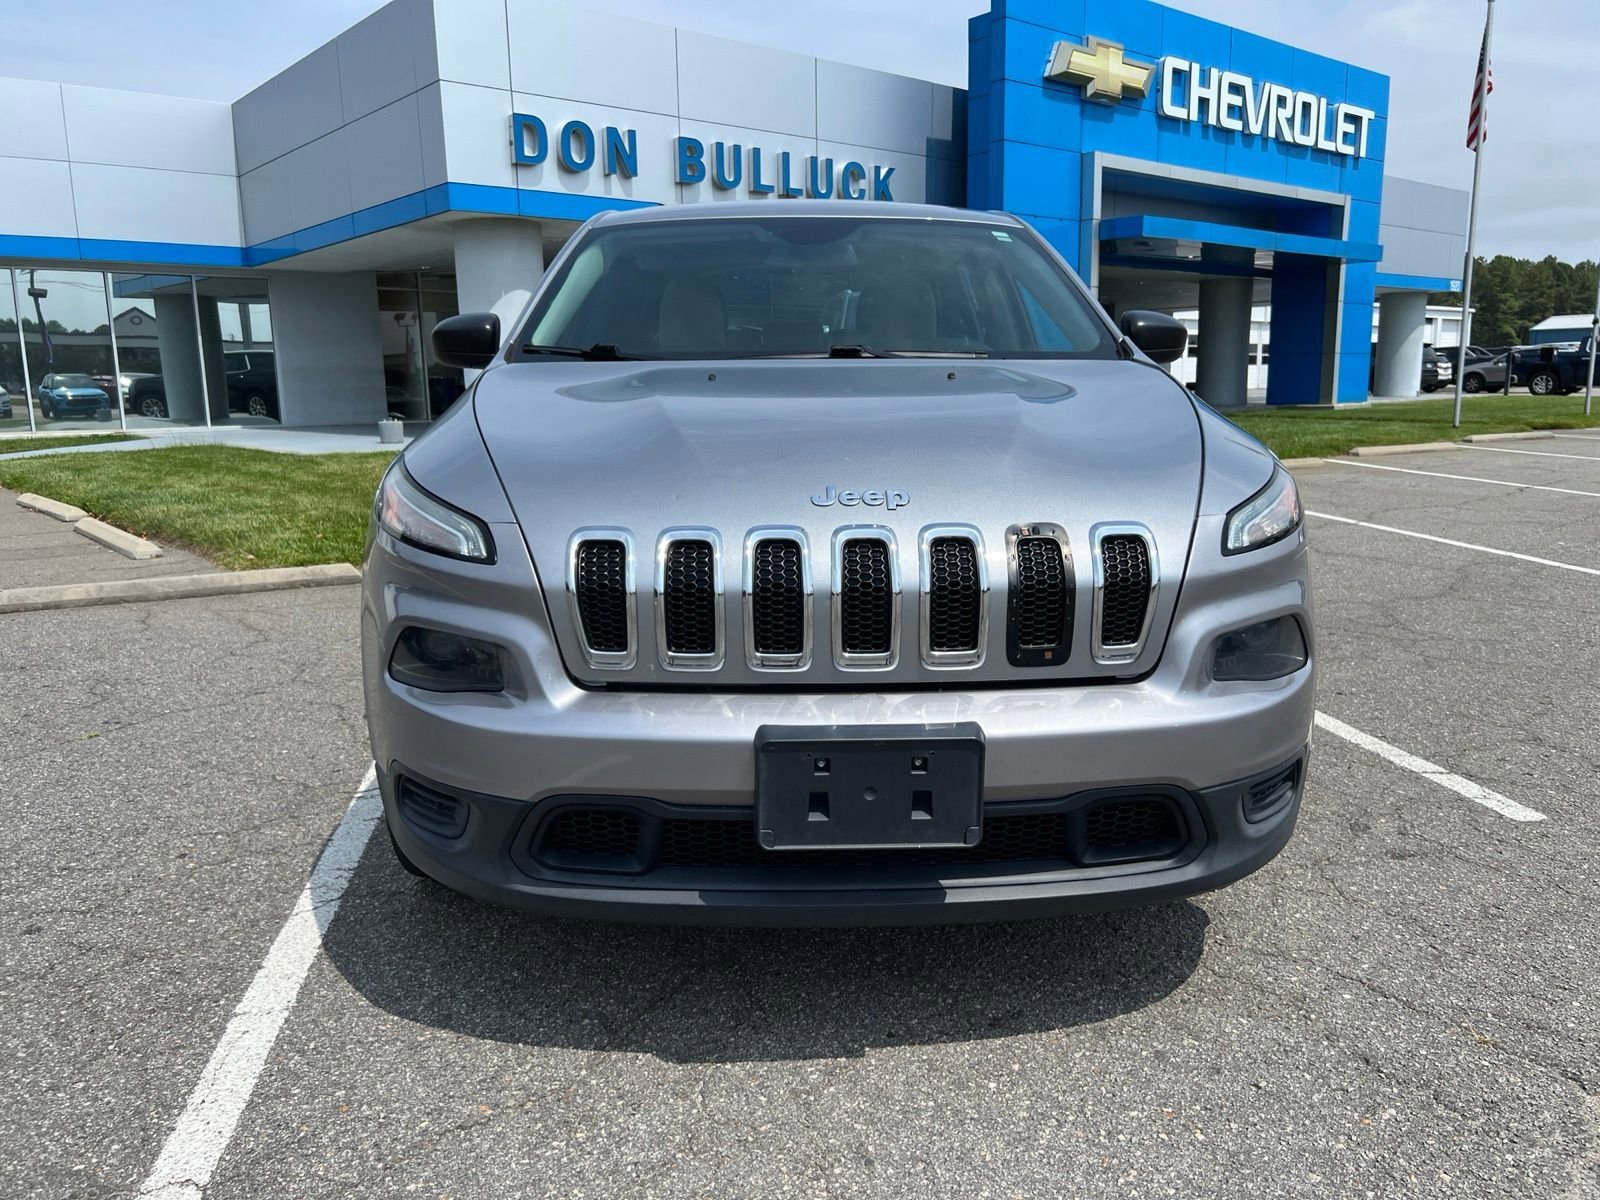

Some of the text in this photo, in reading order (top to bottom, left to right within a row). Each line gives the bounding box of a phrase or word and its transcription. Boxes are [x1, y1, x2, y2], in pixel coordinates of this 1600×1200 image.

[1158, 55, 1376, 158] CHEVROLET
[510, 112, 896, 201] DON BULLUCK
[810, 485, 910, 511] Jeep
